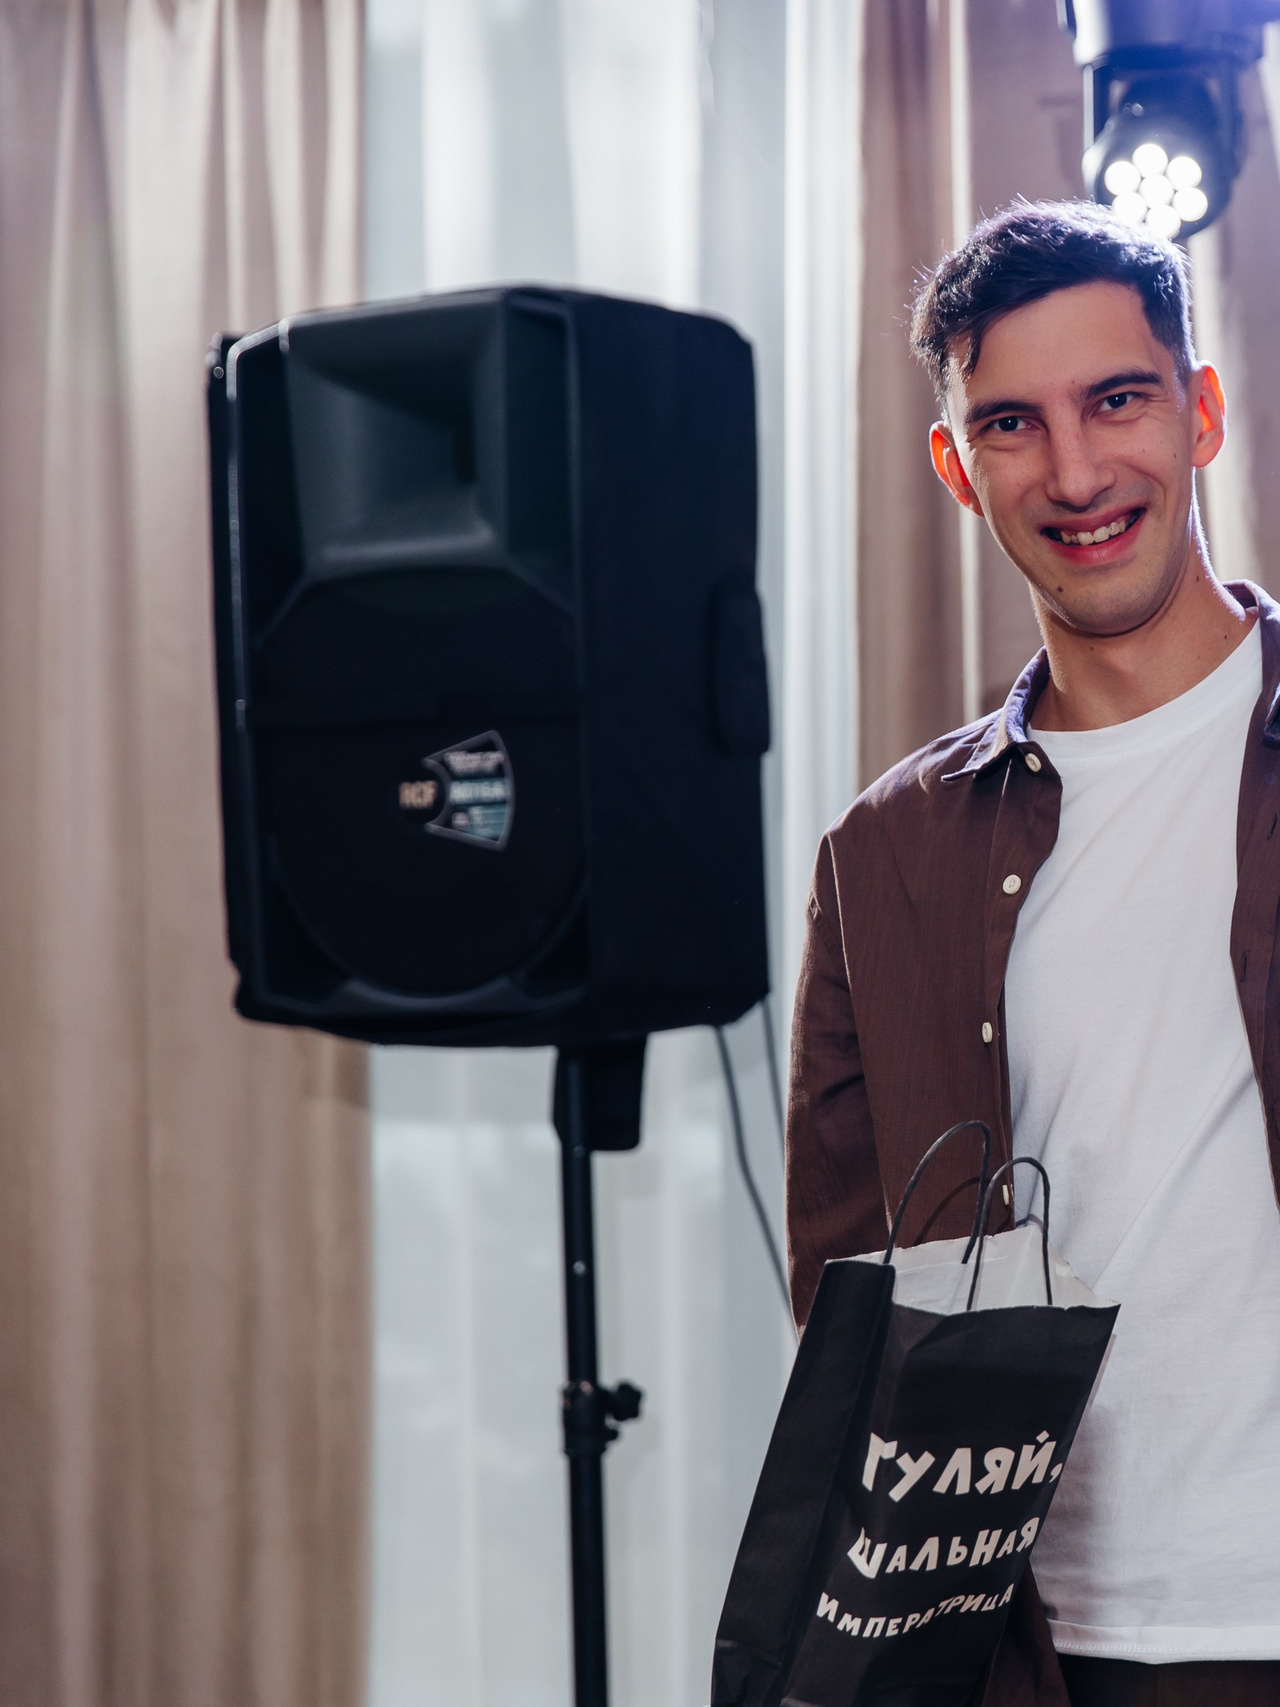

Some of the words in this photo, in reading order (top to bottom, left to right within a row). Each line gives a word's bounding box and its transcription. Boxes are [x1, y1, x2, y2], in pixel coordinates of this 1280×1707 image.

[862, 1430, 1063, 1503] ГУЛЯЙ,
[847, 1517, 1040, 1579] ШАЛЬНАЯ
[816, 1583, 1015, 1638] ИМПЕРАТРИЦА
